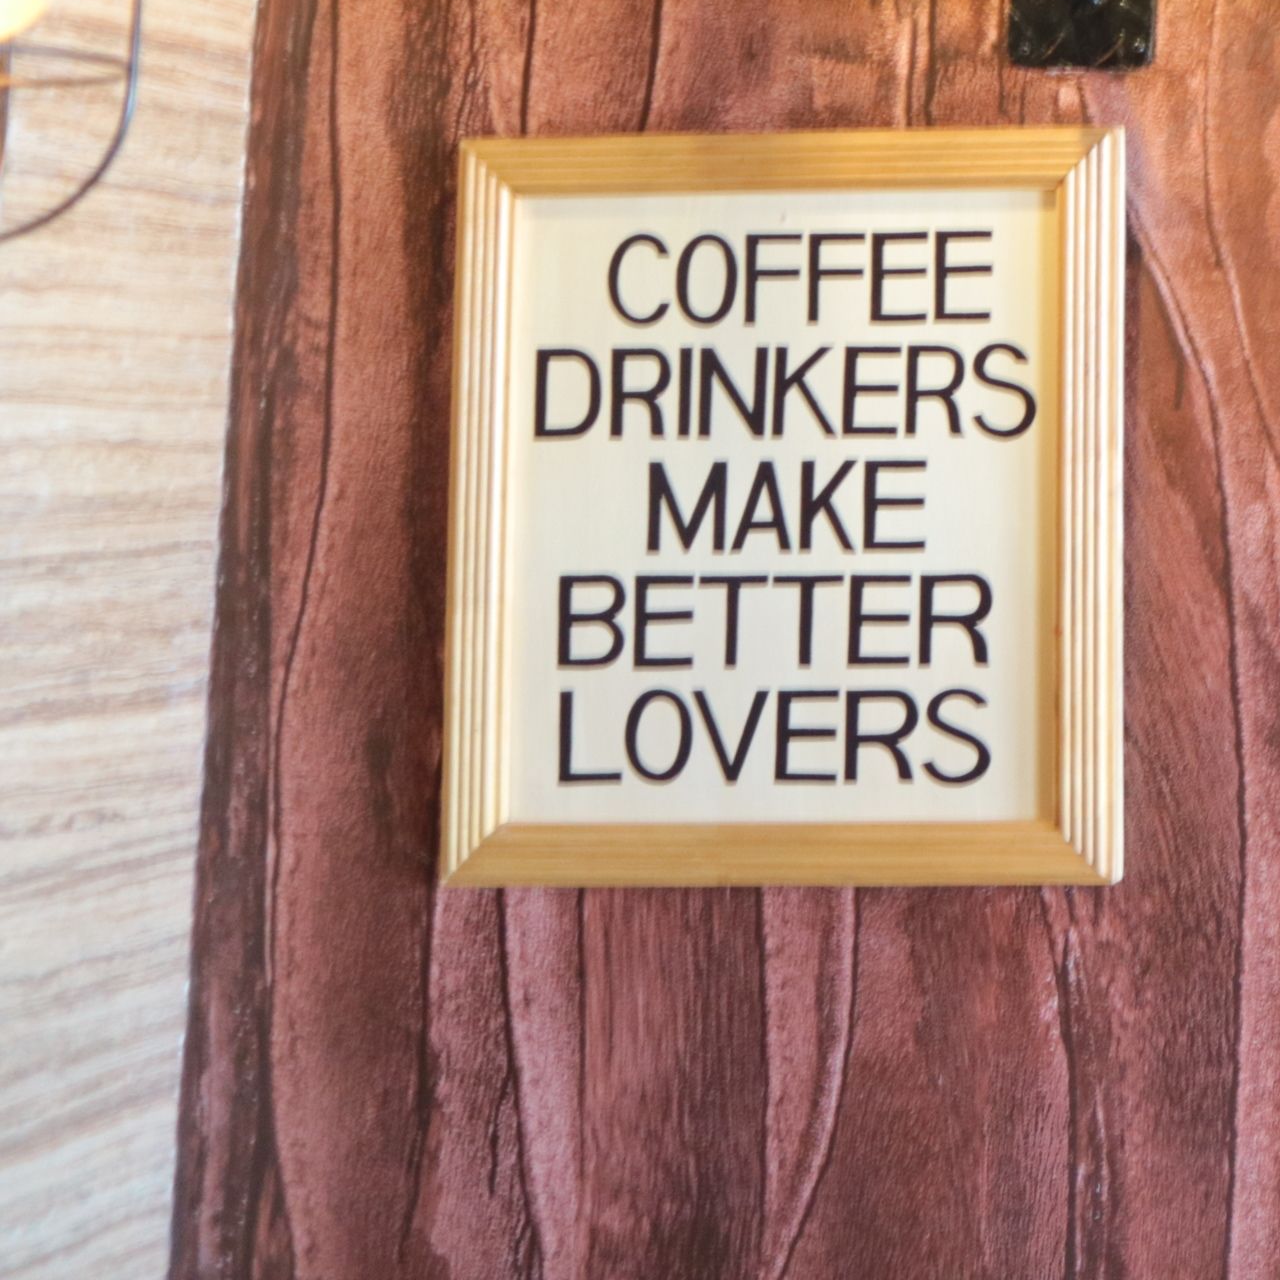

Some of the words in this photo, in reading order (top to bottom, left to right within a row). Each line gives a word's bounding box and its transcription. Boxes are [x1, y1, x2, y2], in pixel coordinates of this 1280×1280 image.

[607, 230, 994, 327] COFFEE
[532, 343, 1038, 440] DRINKERS
[645, 458, 928, 554] MAKE
[556, 572, 994, 669] BETTER
[556, 687, 992, 786] LOVERS
